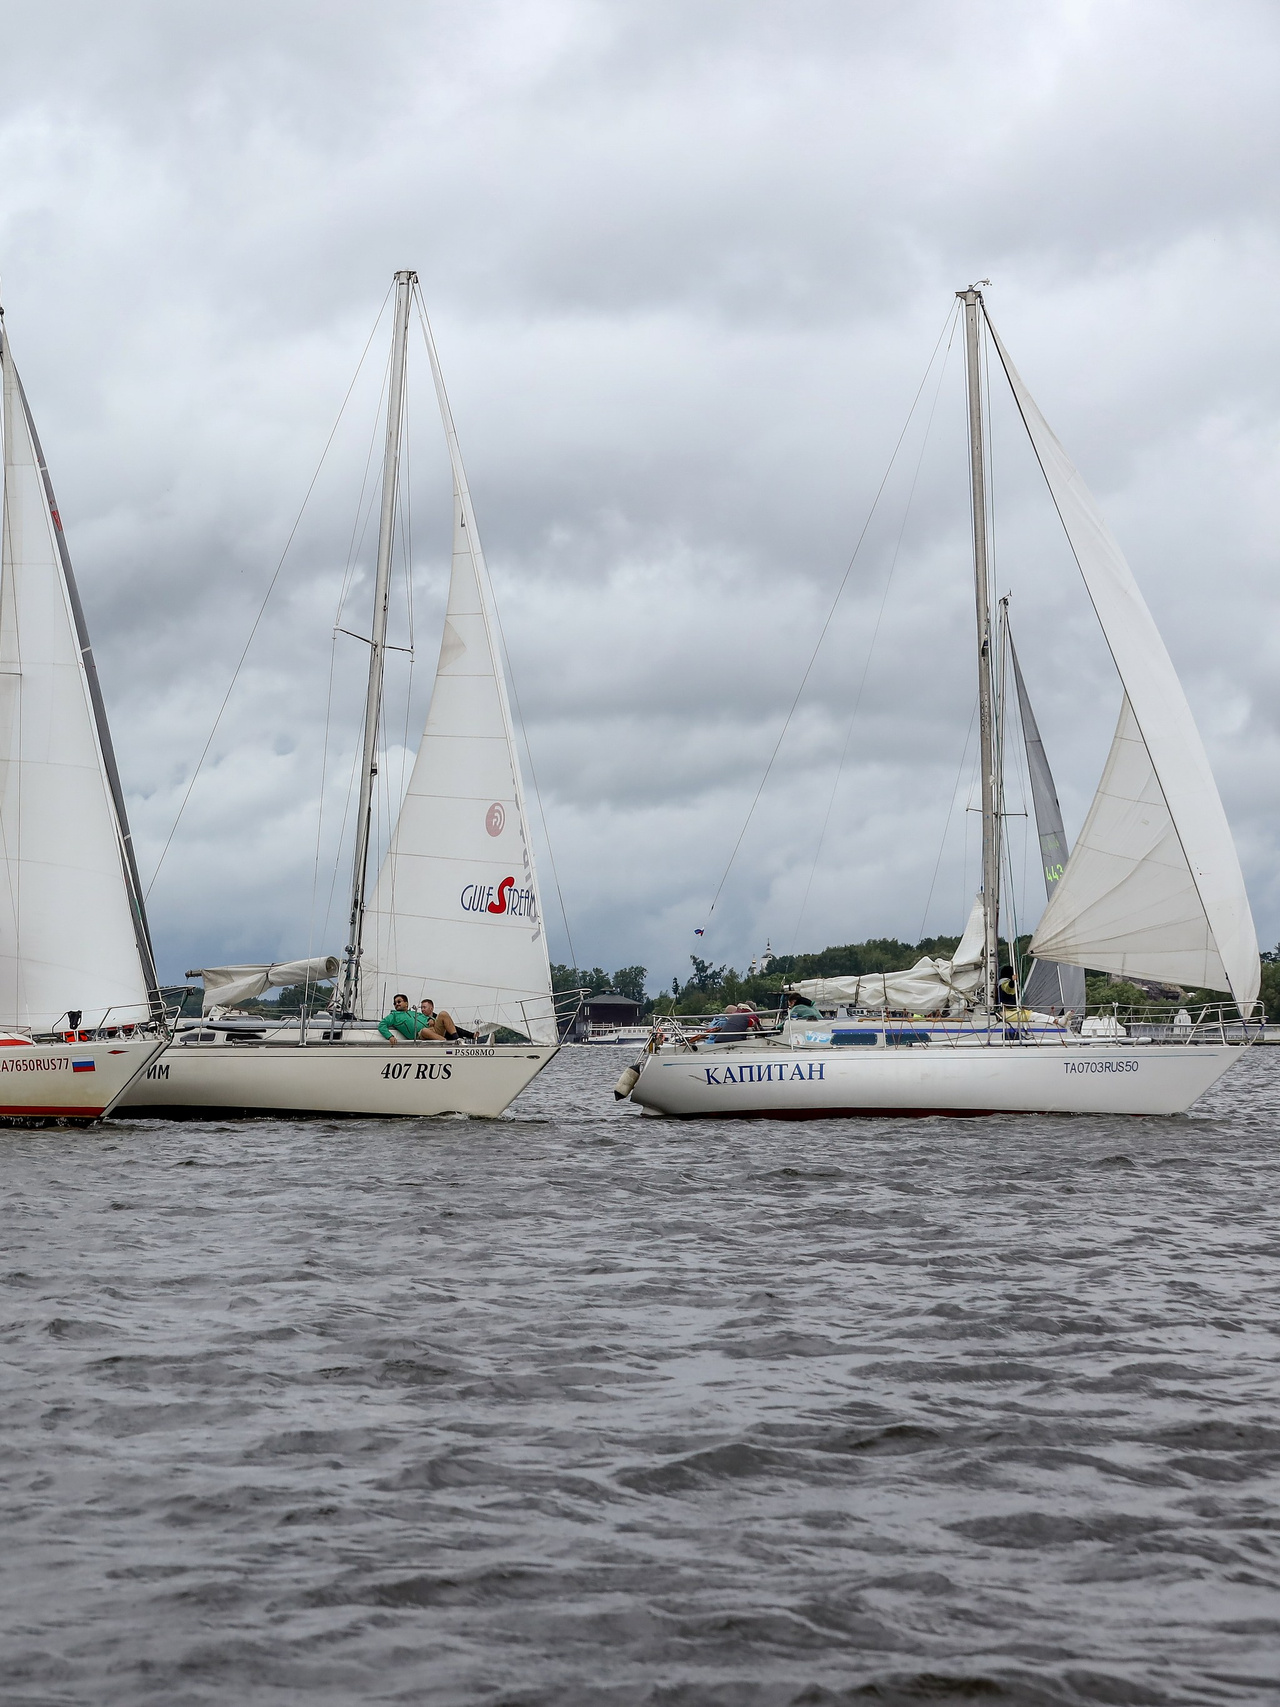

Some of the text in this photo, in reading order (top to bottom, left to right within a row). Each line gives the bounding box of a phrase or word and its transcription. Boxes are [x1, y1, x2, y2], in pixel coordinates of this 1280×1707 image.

[380, 1062, 453, 1080] 407 RUS
[704, 1063, 826, 1086] КАПИТАН
[1064, 1061, 1139, 1074] TA0703RUS50
